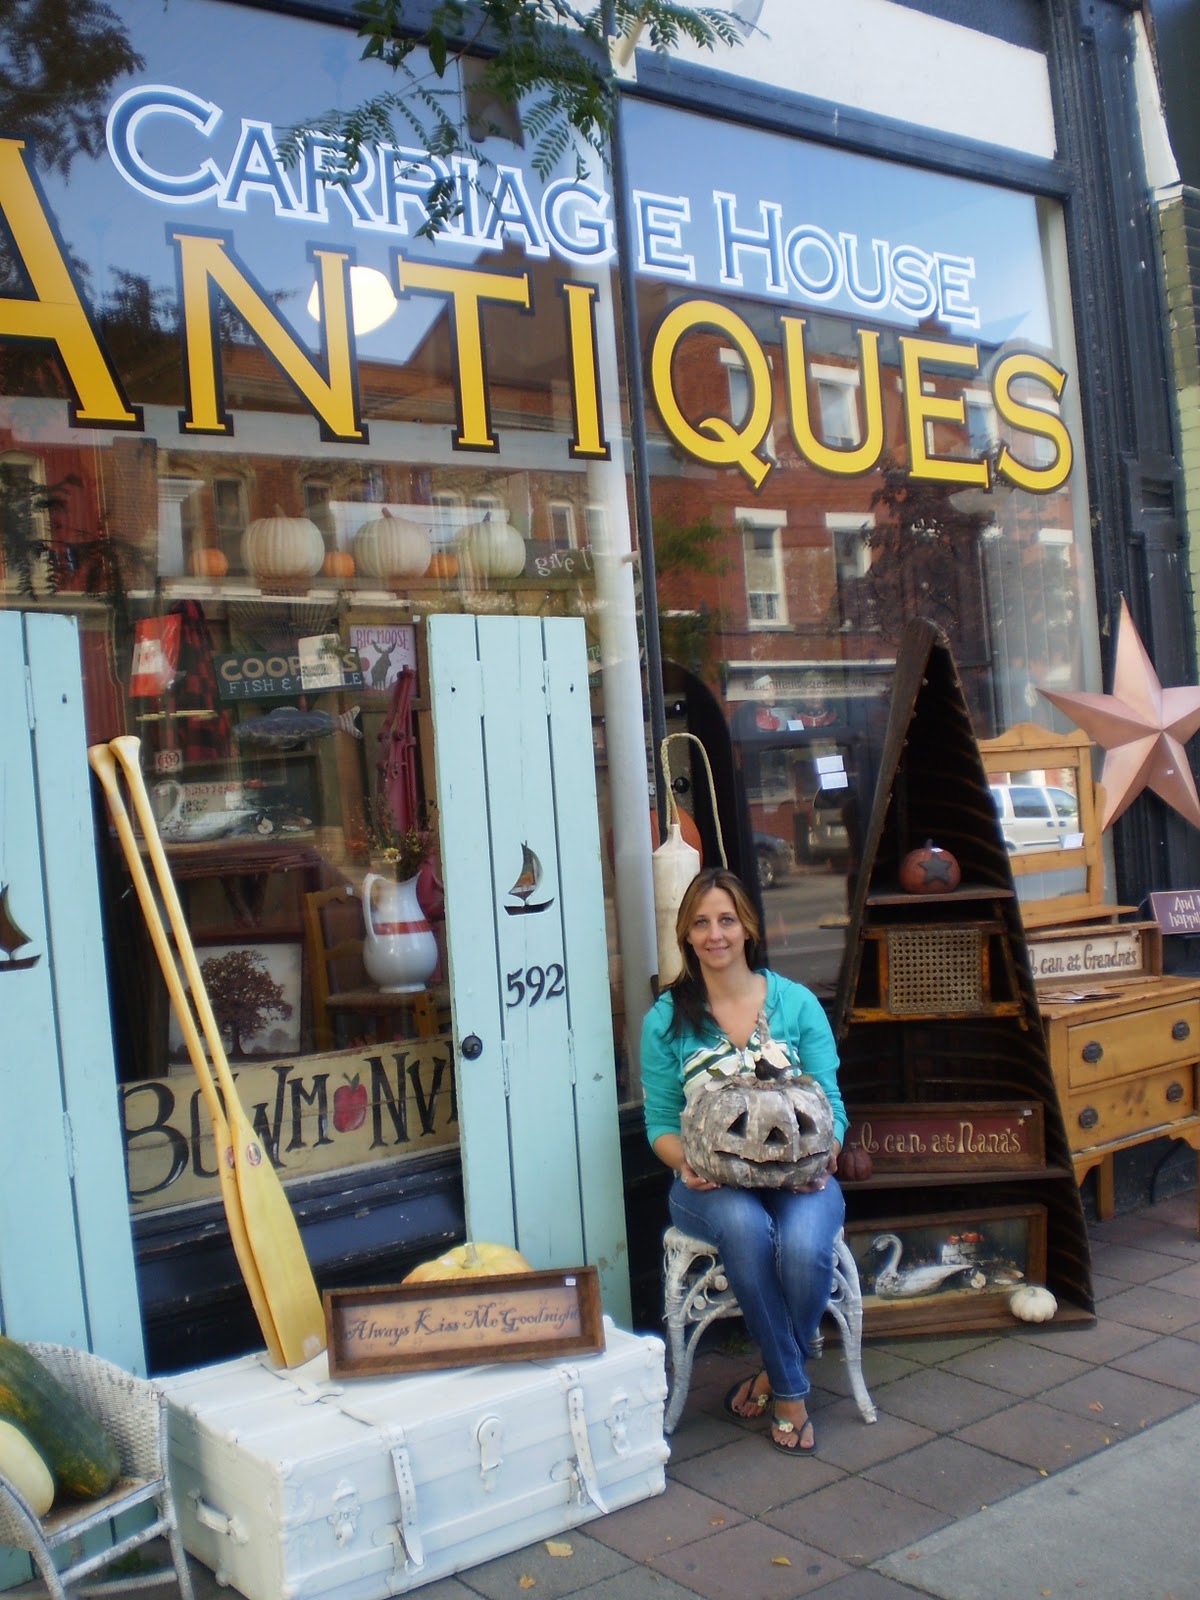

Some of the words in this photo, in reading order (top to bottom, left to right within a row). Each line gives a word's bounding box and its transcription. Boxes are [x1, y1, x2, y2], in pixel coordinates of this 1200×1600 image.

[105, 83, 697, 283] CARRIAGE
[712, 190, 981, 329] HOUSE
[0, 130, 1074, 496] ANTIQUES
[534, 552, 575, 577] give
[356, 629, 373, 652] BIG
[376, 629, 409, 651] MOOSE
[220, 653, 358, 682] COOPS
[229, 678, 275, 694] FISH
[297, 672, 362, 690] ACKLE
[1174, 895, 1196, 914] And
[1040, 957, 1065, 975] can
[1067, 953, 1082, 971] at
[1083, 941, 1137, 972] Grandma's
[505, 963, 566, 1008] 592
[884, 1133, 927, 1154] can
[931, 1133, 955, 1153] at
[957, 1121, 1022, 1154] Nana's
[346, 1319, 410, 1347] Always
[414, 1306, 460, 1336] Kiss
[463, 1303, 499, 1331] Me
